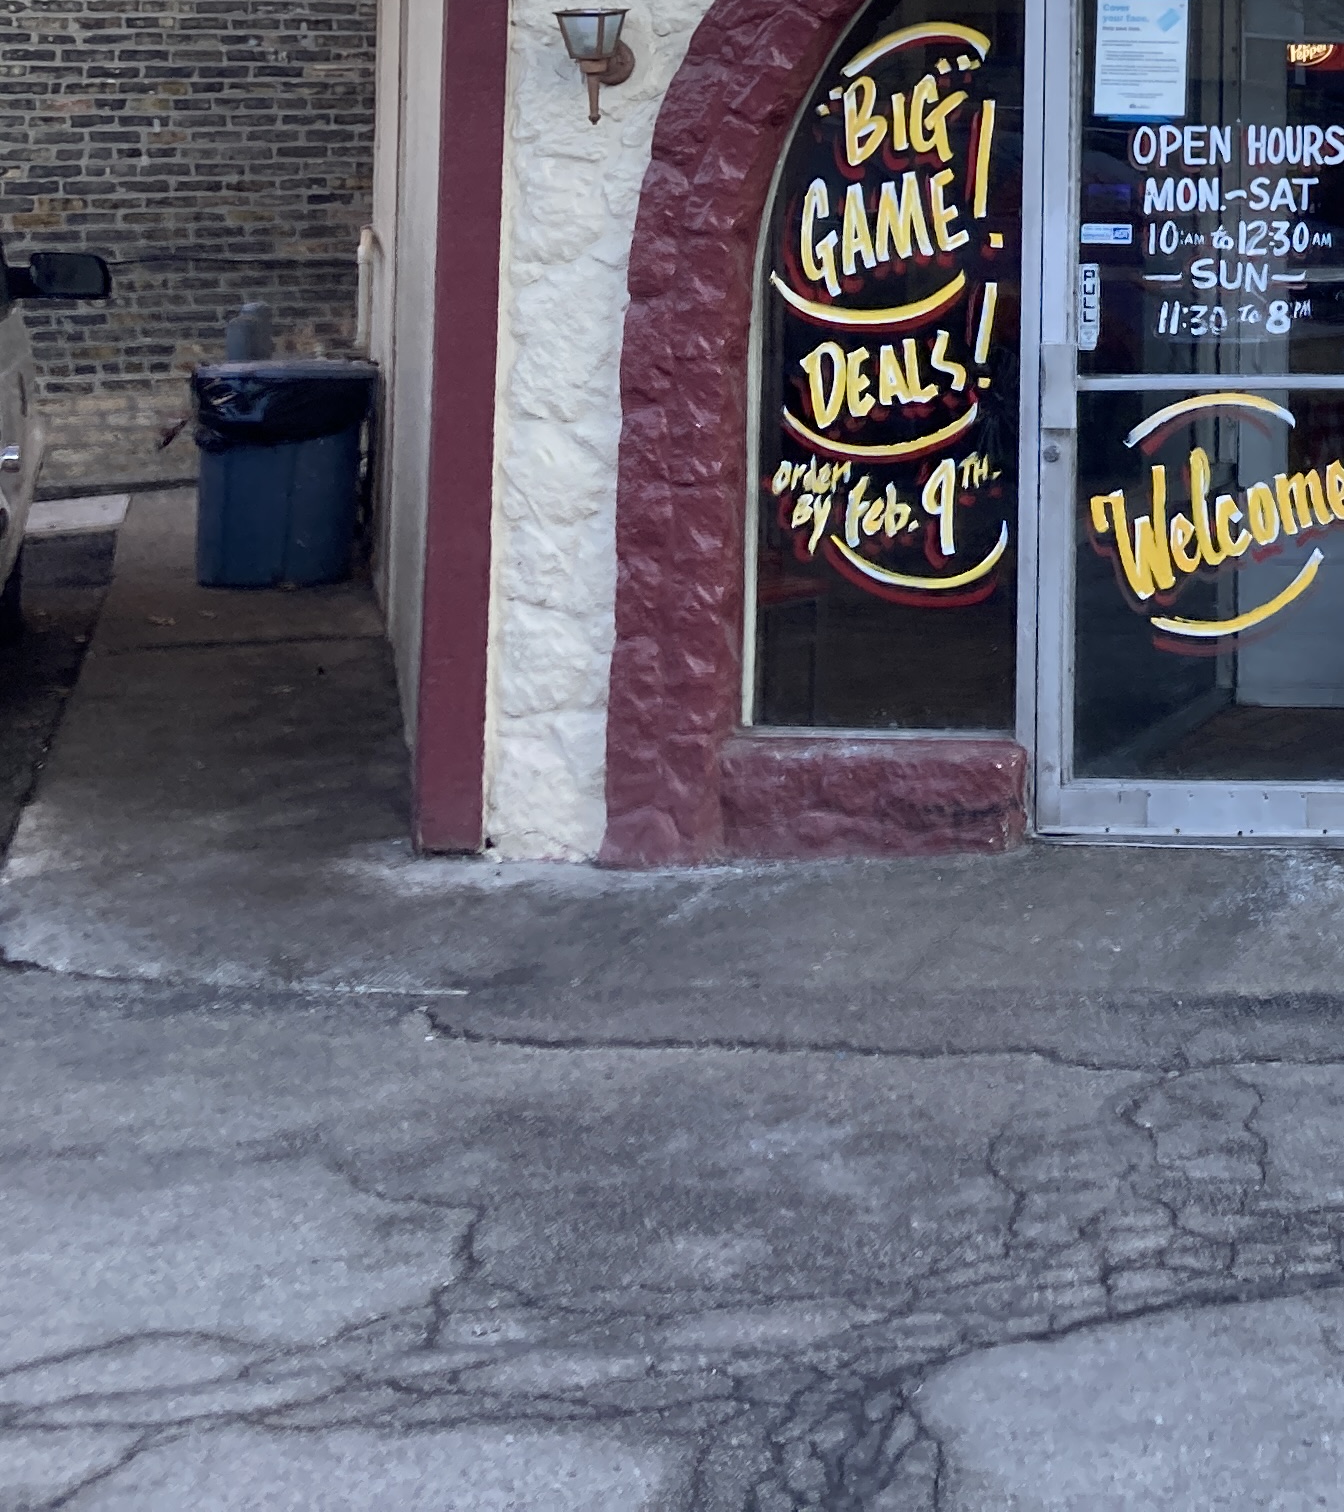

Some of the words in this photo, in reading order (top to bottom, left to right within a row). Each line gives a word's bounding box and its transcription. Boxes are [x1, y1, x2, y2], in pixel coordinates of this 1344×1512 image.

[842, 74, 969, 167] BIG
[1133, 125, 1231, 167] OPEN
[1211, 224, 1234, 250] to
[1083, 269, 1096, 323] PULL
[1190, 258, 1269, 292] SUN
[1158, 300, 1228, 336] 11:30
[799, 282, 998, 430] DEALS!
